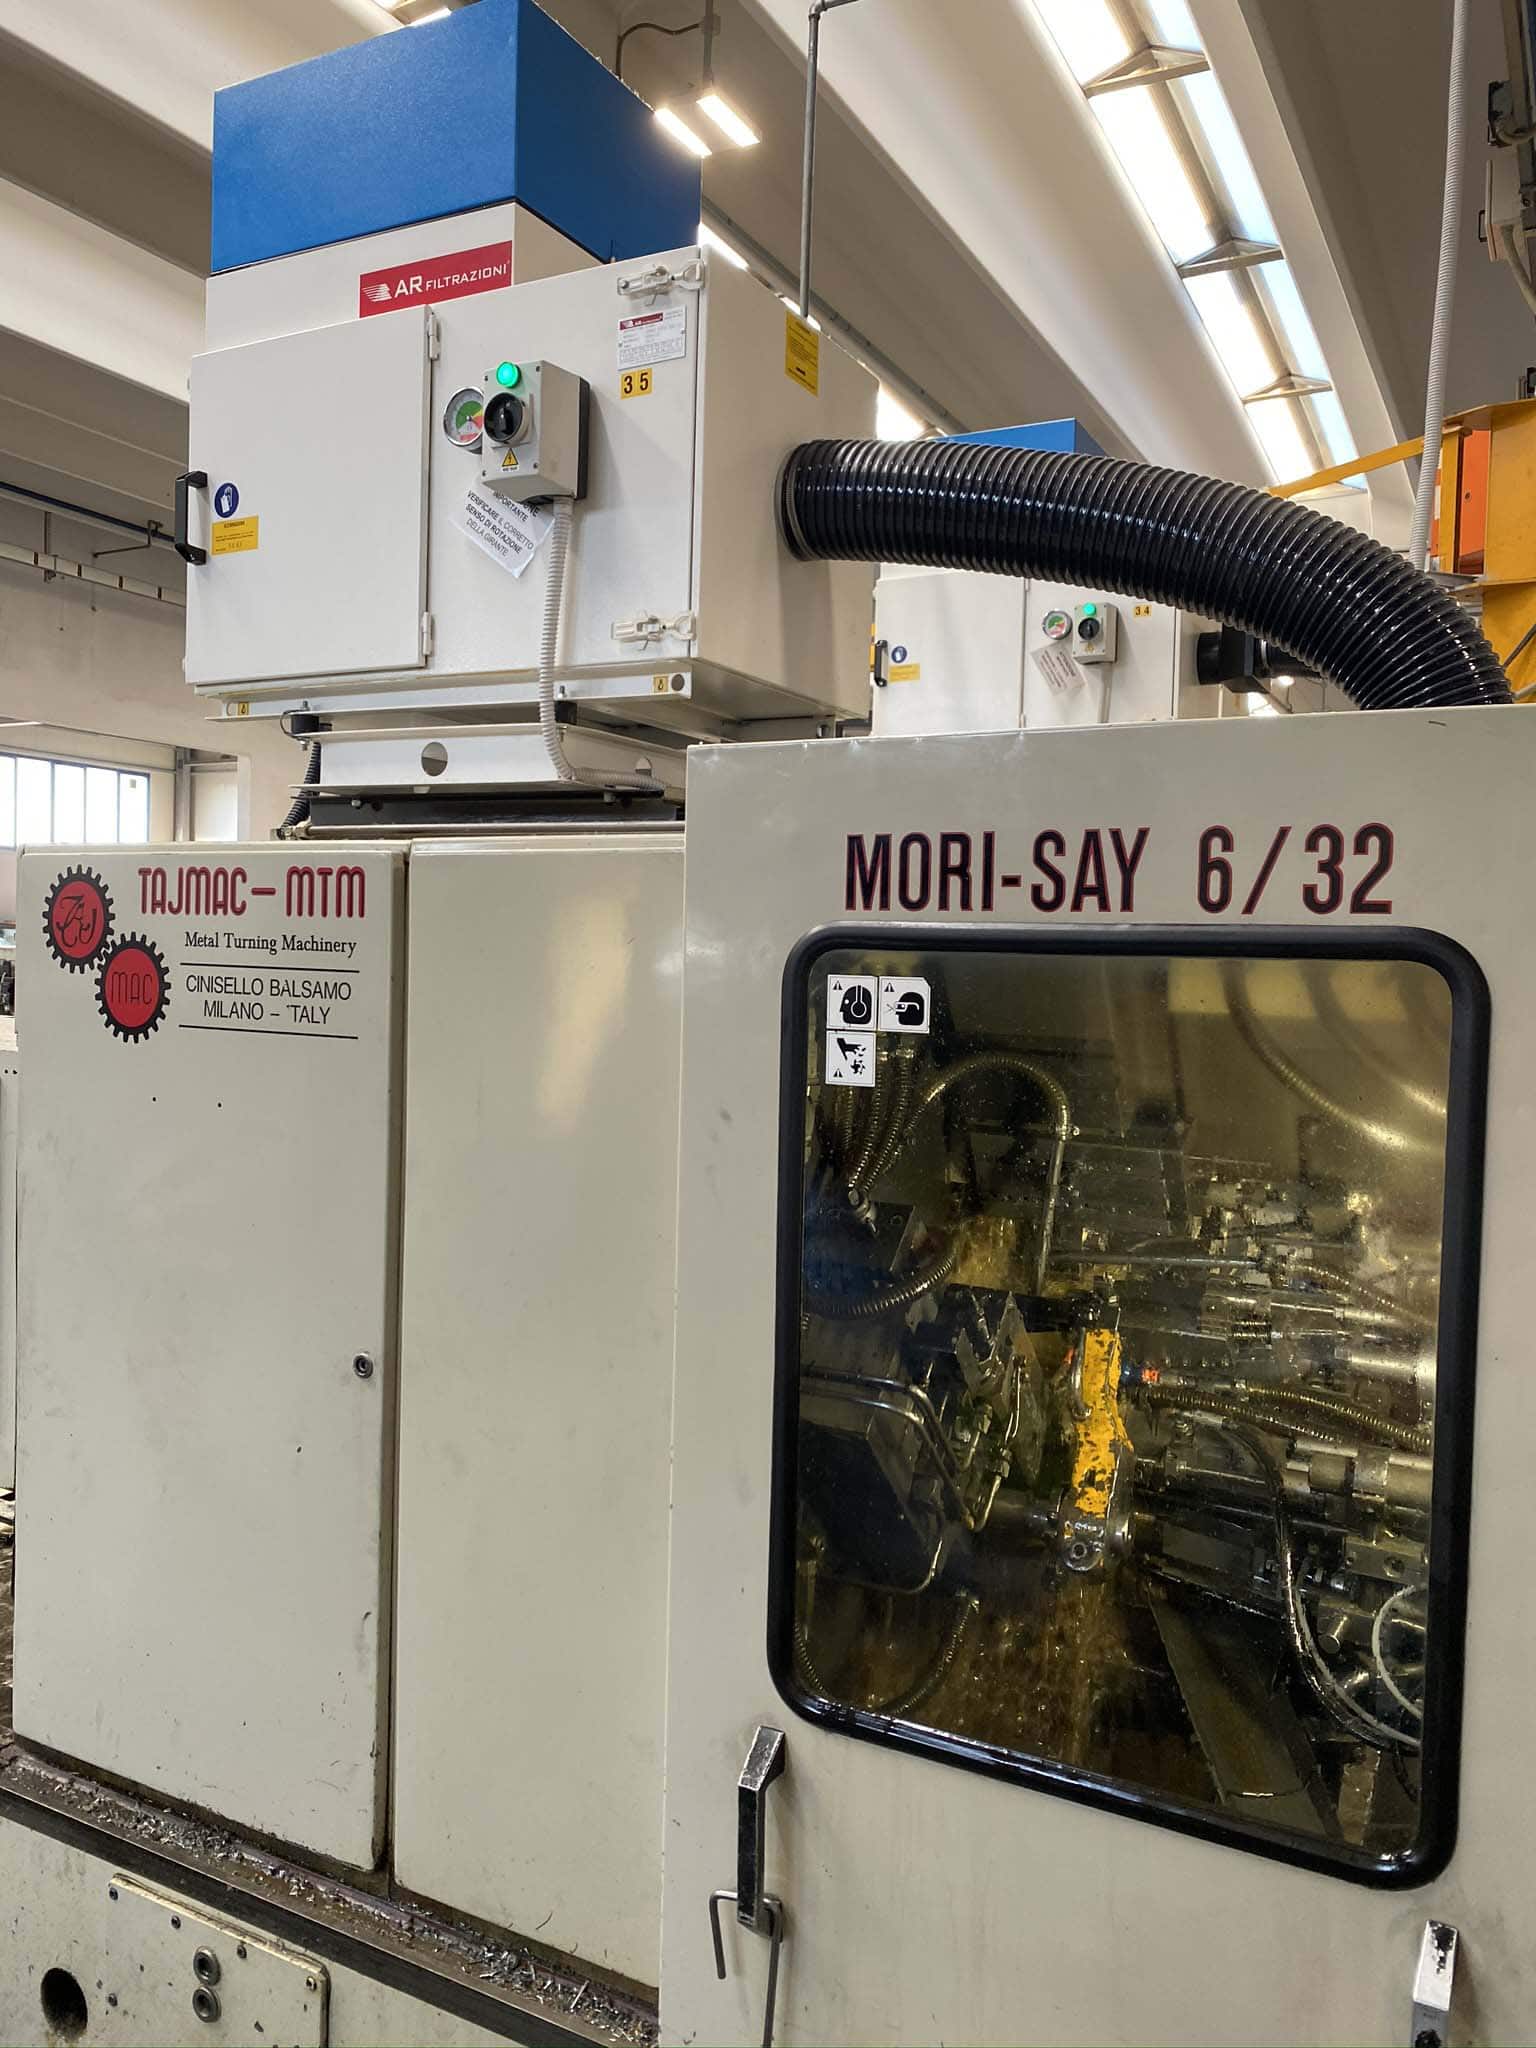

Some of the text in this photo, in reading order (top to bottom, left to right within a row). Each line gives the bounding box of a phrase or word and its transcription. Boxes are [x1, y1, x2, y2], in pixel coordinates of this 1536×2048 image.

[394, 263, 507, 298] AR FILTRAZIONI
[465, 503, 523, 554] SENSO DI ROTAZIONE
[466, 518, 509, 557] DELLA GIRANTE
[467, 490, 500, 520] VERIFICARE
[503, 522, 535, 550] CORRETTO
[844, 822, 1395, 915] MORI-SAY 6/32
[184, 931, 357, 958] Metal Turning Machinery
[111, 971, 153, 1005] MAC
[186, 974, 352, 1001] CINISELLO BALSAMO
[203, 999, 264, 1021] MILANO
[286, 1004, 331, 1025] TALY
